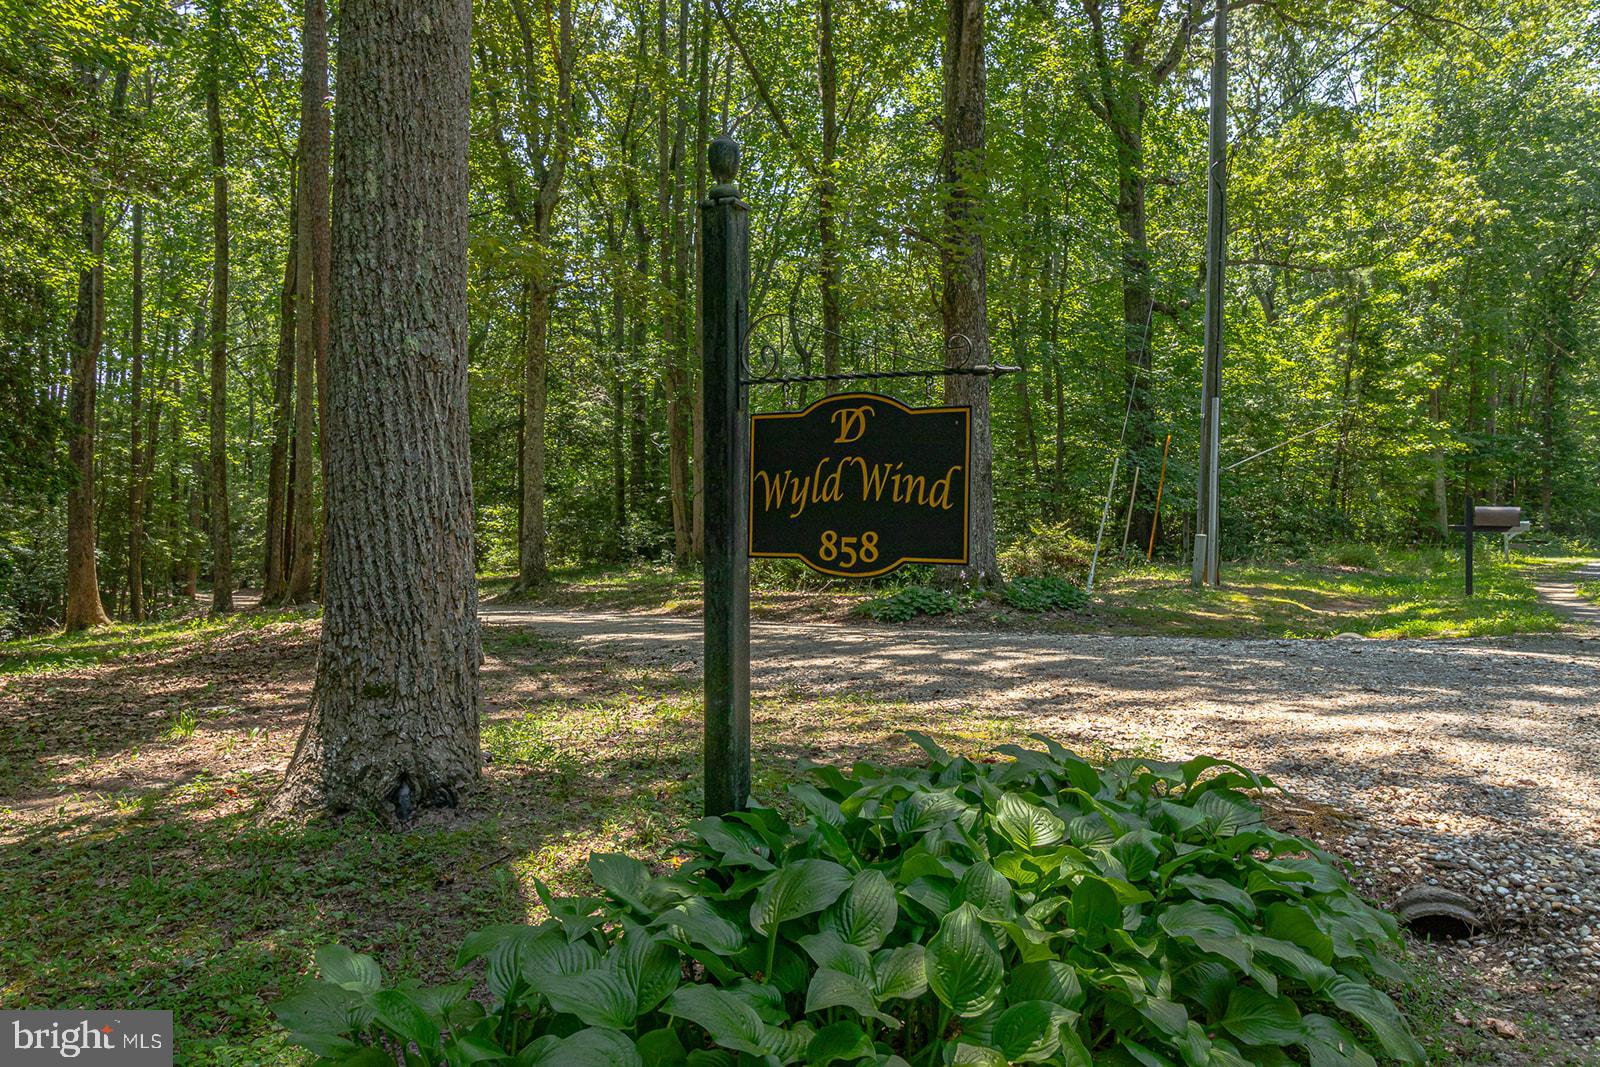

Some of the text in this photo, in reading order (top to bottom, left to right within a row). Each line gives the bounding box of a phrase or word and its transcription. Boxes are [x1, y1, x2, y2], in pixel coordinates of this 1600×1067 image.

[754, 457, 962, 518] Wyld Wind
[819, 530, 879, 568] 858
